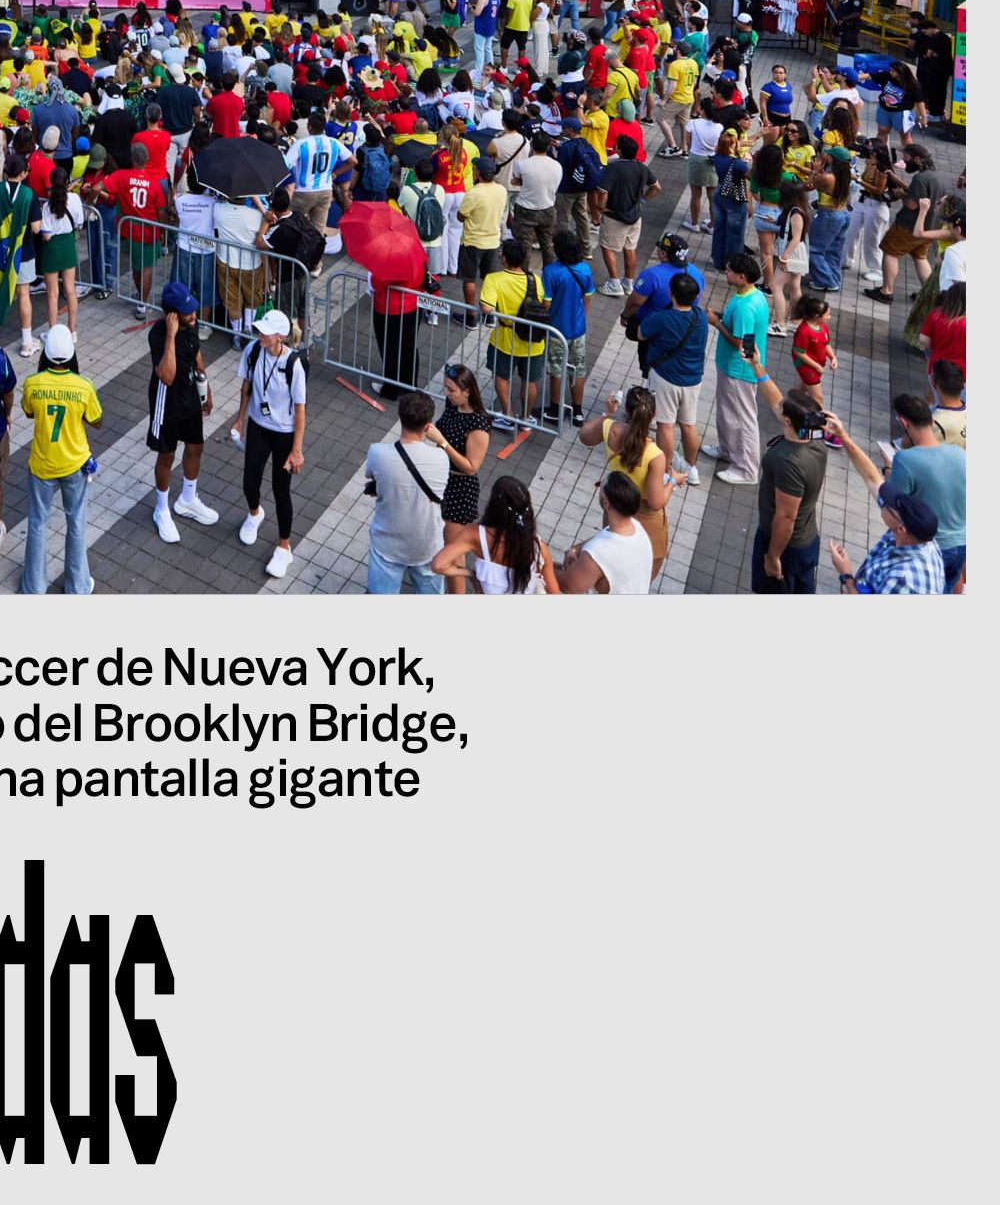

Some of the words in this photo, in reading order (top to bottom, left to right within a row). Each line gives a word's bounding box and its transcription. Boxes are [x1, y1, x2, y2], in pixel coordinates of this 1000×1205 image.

[311, 152, 330, 175] 10
[129, 177, 150, 187] BRAHIM
[130, 187, 148, 209] 10
[418, 296, 450, 312] NATIONAL
[32, 388, 83, 403] RONALDINHO
[46, 404, 66, 443] 7
